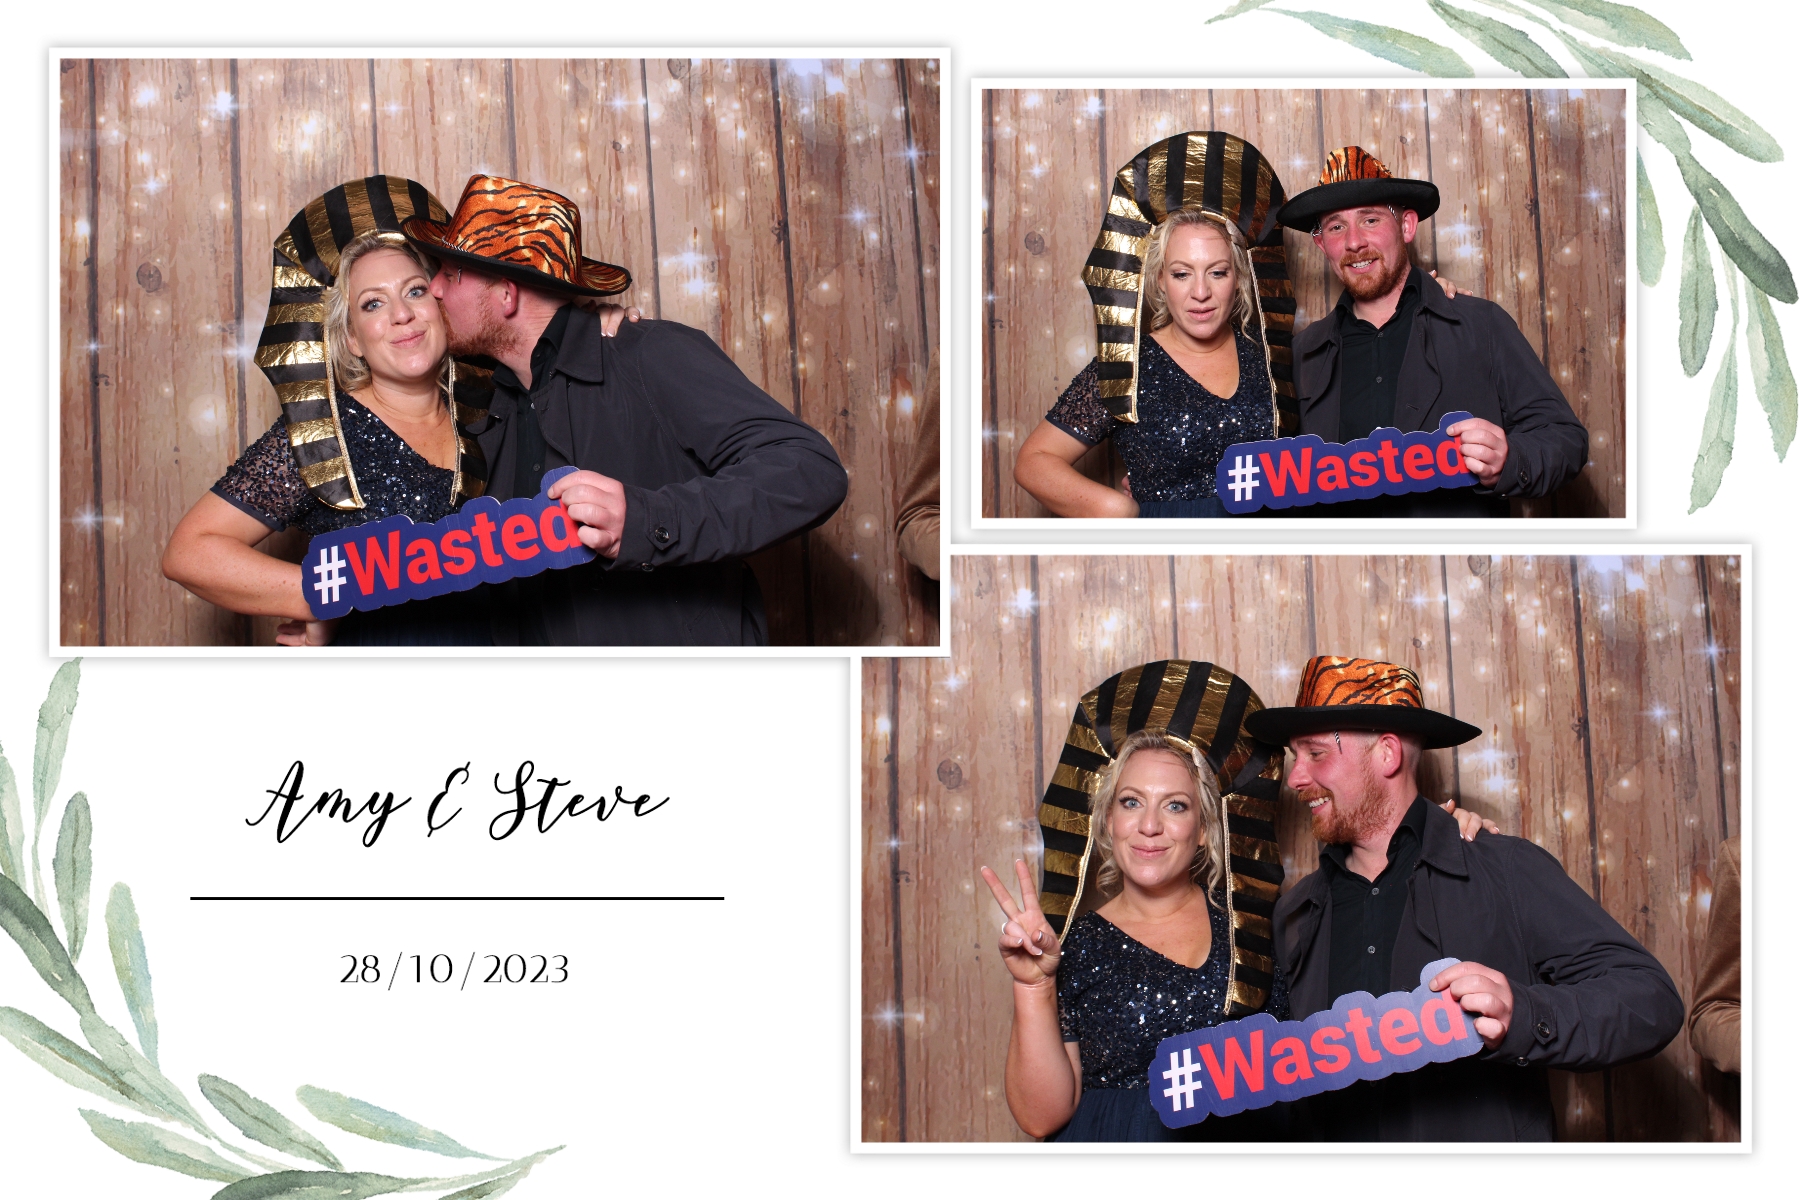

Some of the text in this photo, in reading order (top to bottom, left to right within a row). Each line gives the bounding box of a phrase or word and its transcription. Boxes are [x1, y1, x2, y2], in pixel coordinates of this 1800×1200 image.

[1227, 434, 1470, 502] #Wasted
[313, 498, 584, 605] #Wasted
[1162, 987, 1469, 1113] #Wasted
